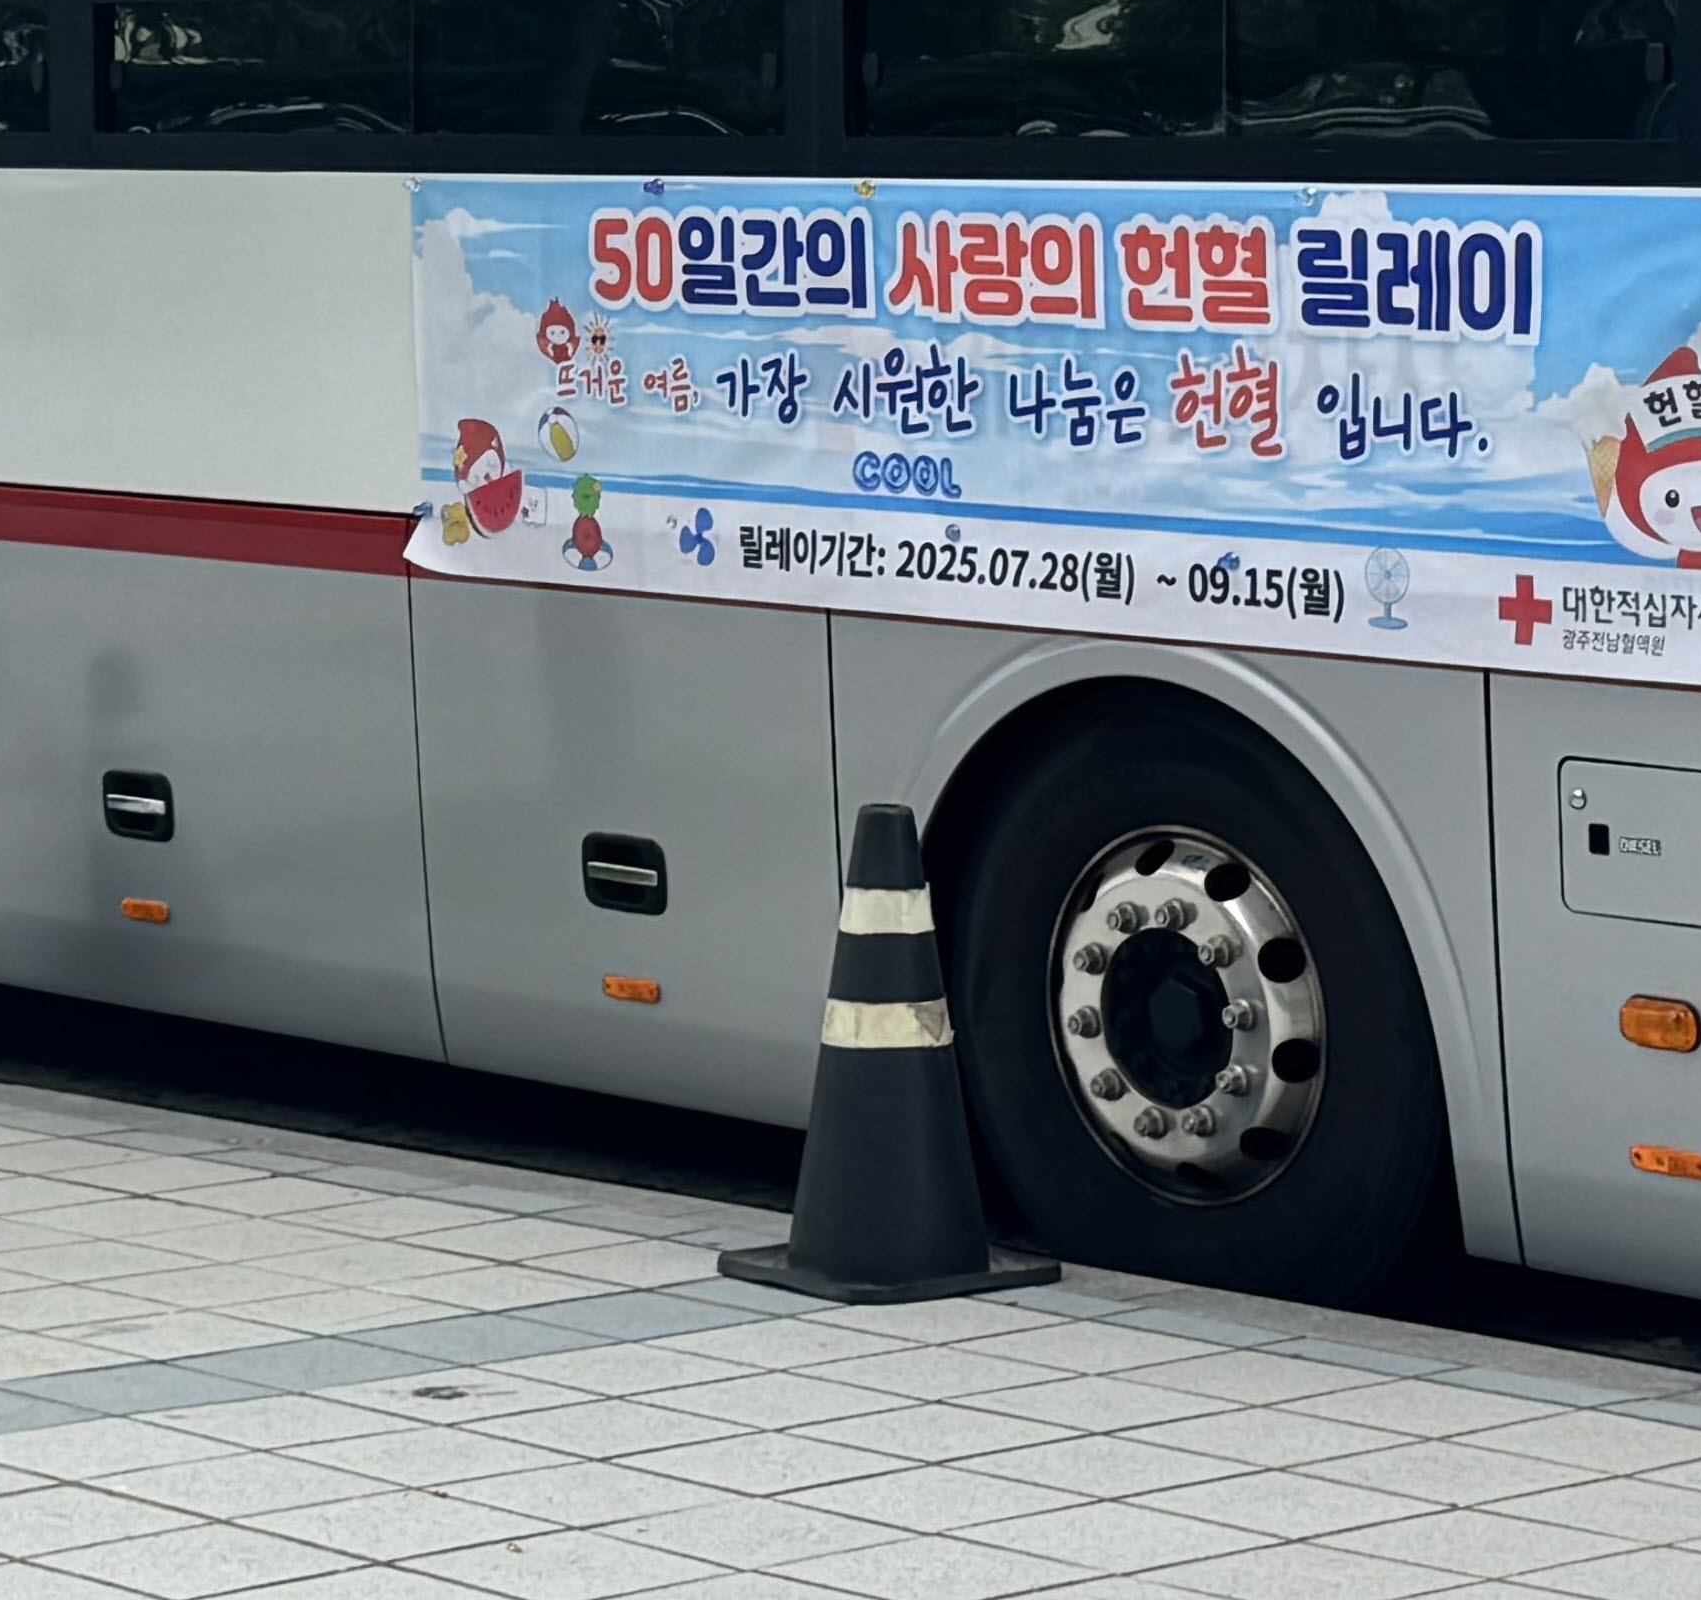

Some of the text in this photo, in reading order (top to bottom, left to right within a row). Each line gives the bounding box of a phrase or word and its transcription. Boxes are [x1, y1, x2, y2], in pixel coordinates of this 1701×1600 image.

[594, 215, 1533, 335] 50일간의 사랑의 헌혈 릴레이
[556, 343, 1489, 460] 뜨거운 여름, 가장 시원한 나눔은 헌혈 입니다.
[852, 450, 962, 500] COOL
[739, 524, 887, 578] 릴레이기간:
[895, 540, 1135, 606] 2025.07.28(월)
[1187, 563, 1346, 624] 09.15(월)
